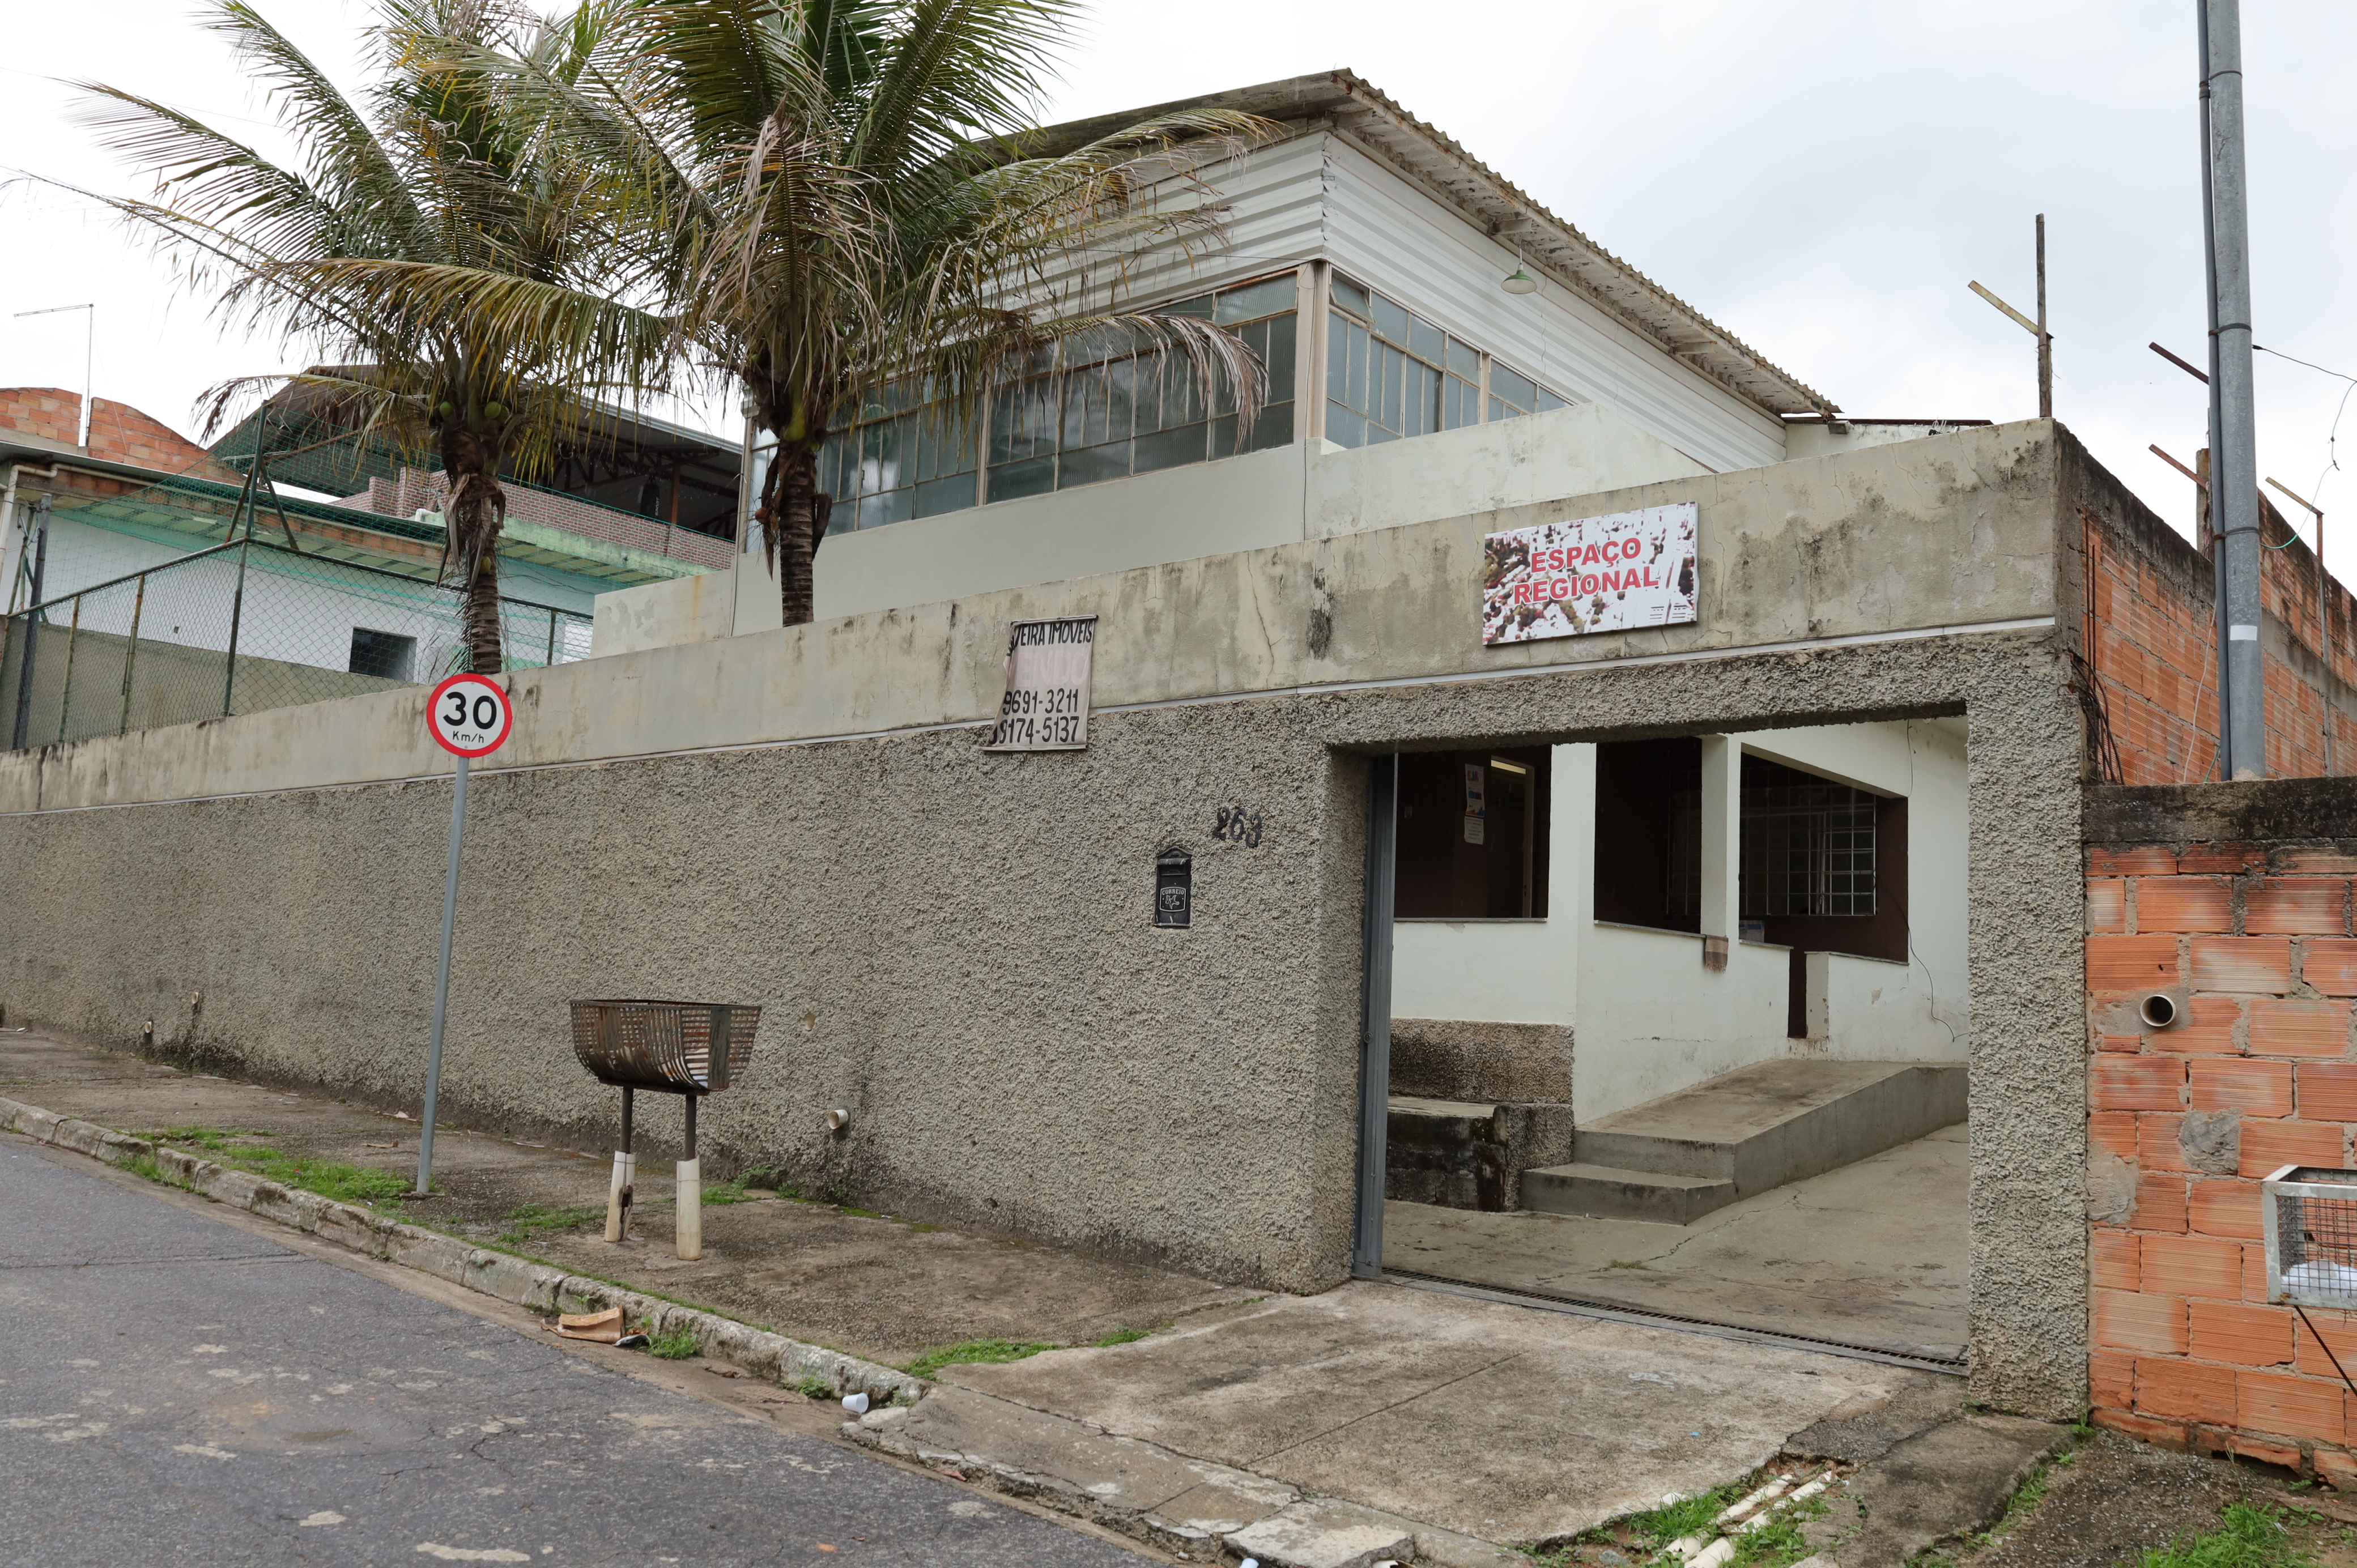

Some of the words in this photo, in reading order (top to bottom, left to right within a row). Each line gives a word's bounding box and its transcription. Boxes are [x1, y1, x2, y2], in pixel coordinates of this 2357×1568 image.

[1531, 537, 1641, 574] ESPAÇO
[1514, 565, 1659, 605] REGIONAL
[1007, 623, 1045, 653] VEIRA
[1009, 649, 1090, 687] ENDO
[443, 691, 497, 730] 30
[453, 731, 484, 743] Km/h
[1212, 806, 1263, 847] 263
